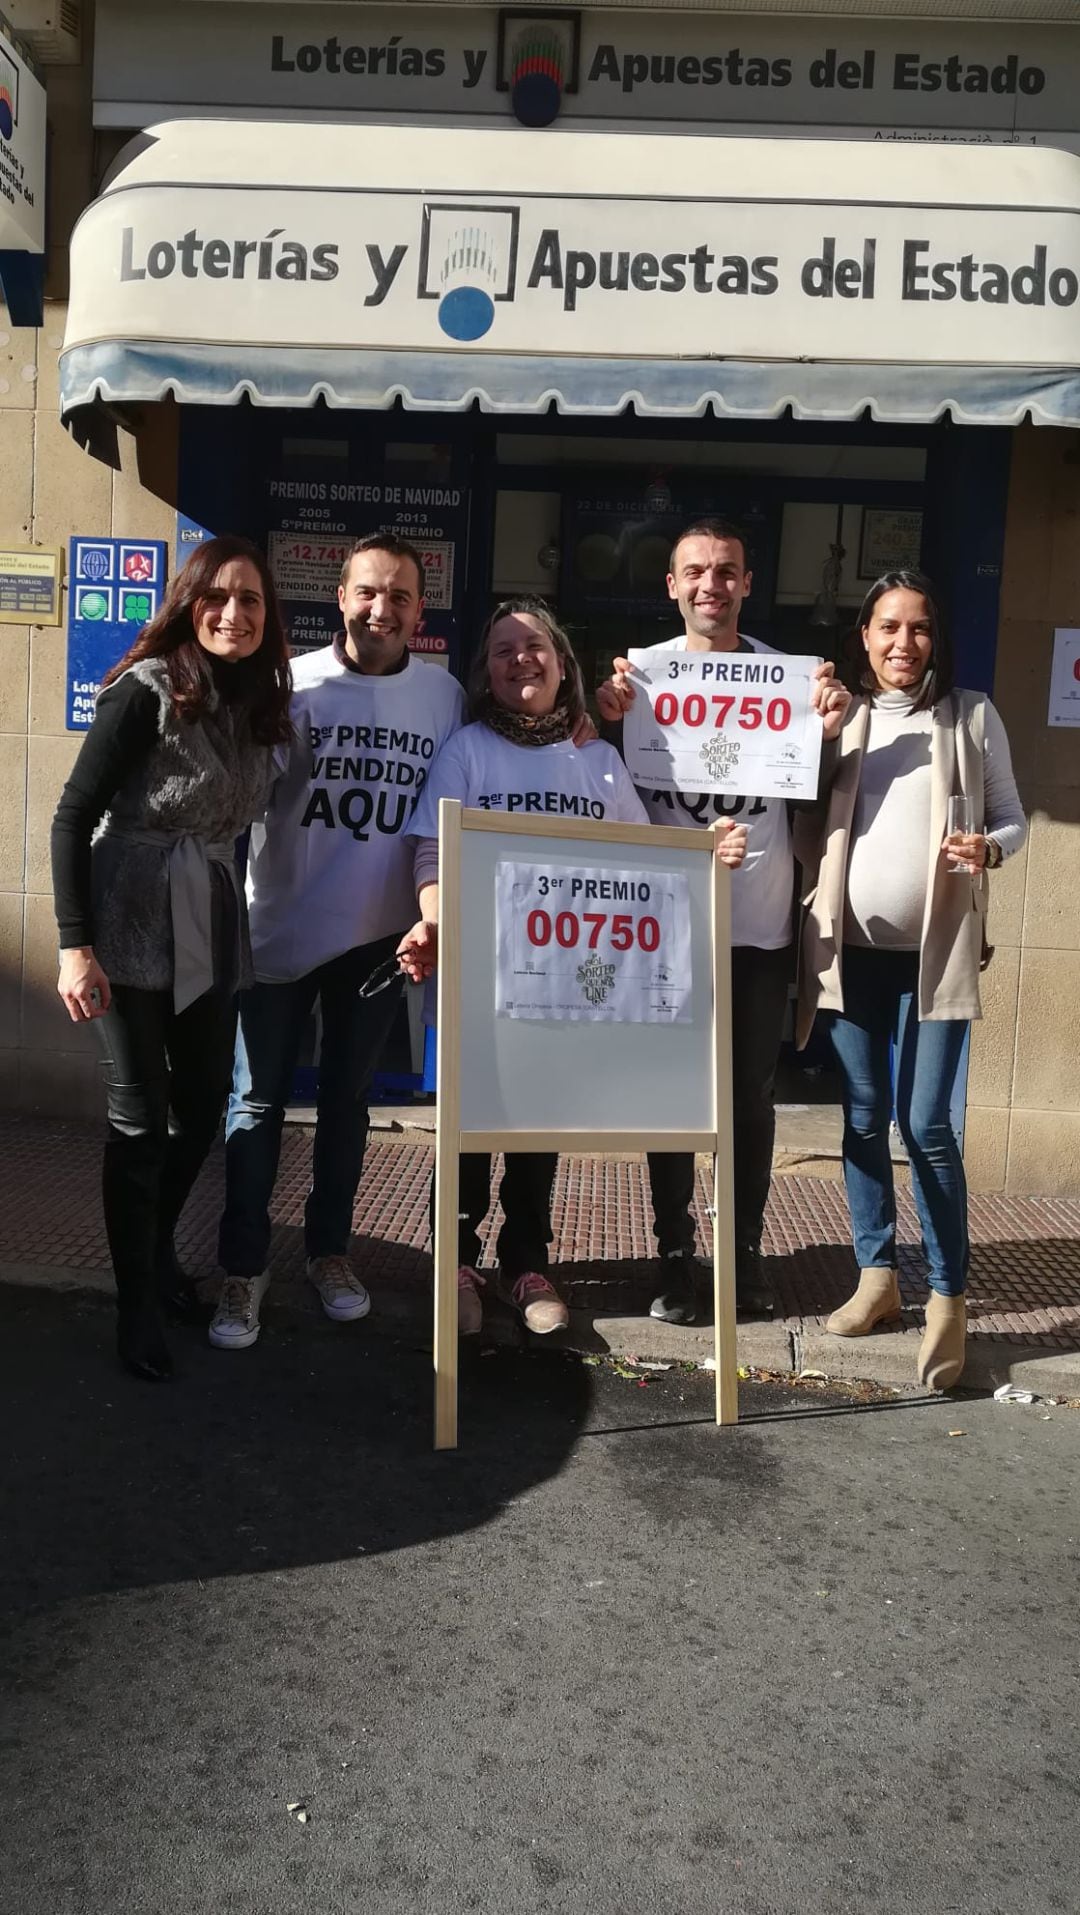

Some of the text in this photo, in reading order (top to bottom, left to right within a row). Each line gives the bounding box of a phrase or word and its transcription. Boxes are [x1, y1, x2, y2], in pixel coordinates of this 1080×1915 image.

[270, 36, 1046, 96] Loterías y Apuestas del Estado
[120, 227, 1079, 312] Loterías y Apuestas del Estado
[269, 481, 460, 507] PREMIOS SORTEO DE NAVIDAD
[299, 507, 331, 519] 2005
[396, 512, 428, 524] 2013
[275, 581, 319, 592] VENDIDO
[294, 616, 325, 627] 2015
[668, 661, 785, 684] 3er PREMIO
[72, 711, 97, 723] Est
[654, 692, 792, 732] 00750
[337, 725, 434, 760] PREMIO
[310, 757, 427, 788] VENDIDO
[507, 791, 605, 820] PREMIO
[538, 876, 650, 902] 3er PREMIO
[527, 909, 661, 953] 00750
